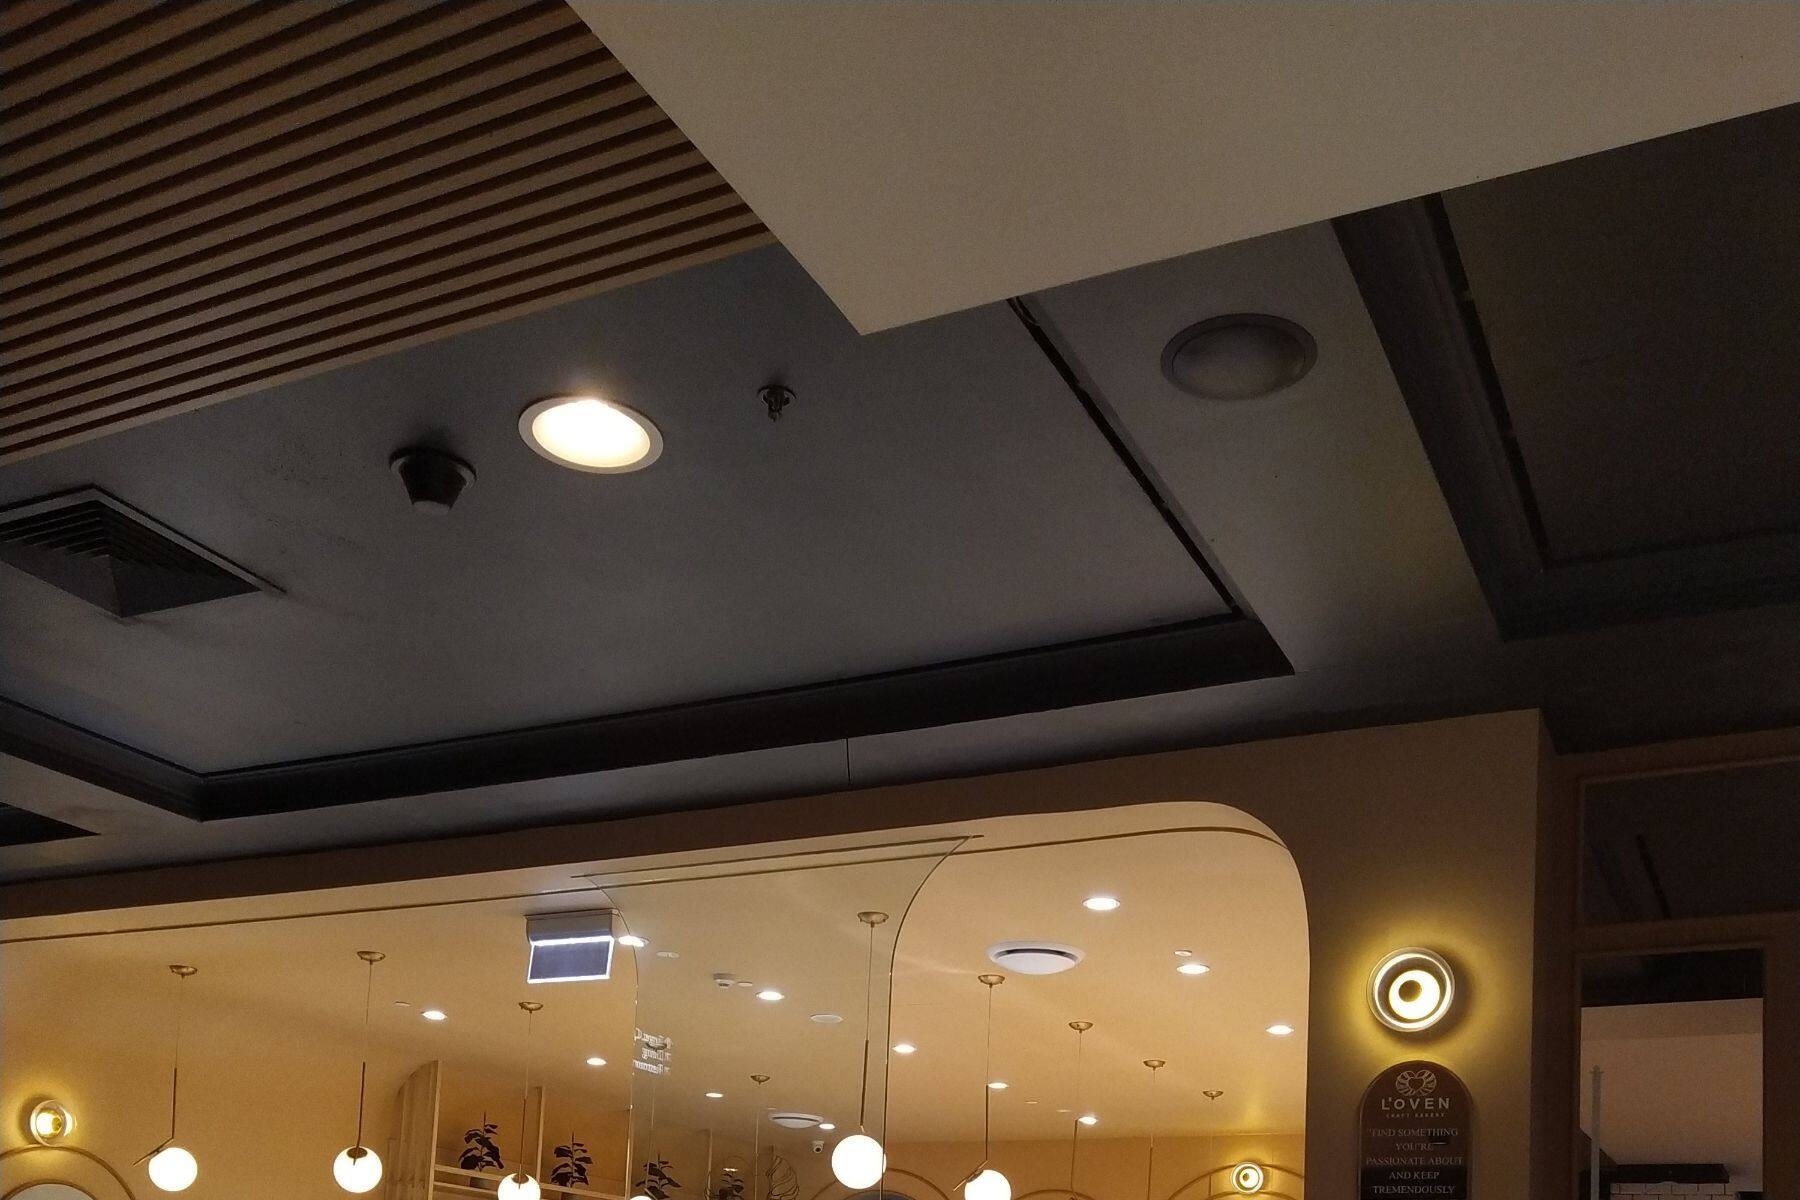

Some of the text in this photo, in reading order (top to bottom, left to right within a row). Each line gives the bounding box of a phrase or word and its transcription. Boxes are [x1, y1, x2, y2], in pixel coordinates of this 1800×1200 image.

[1381, 1097, 1450, 1110] L'OVEN
[1398, 1127, 1459, 1137] SOMETHING
[1389, 1171, 1440, 1180] AND KEEP
[1372, 1185, 1455, 1194] TREMENDOUSLY
